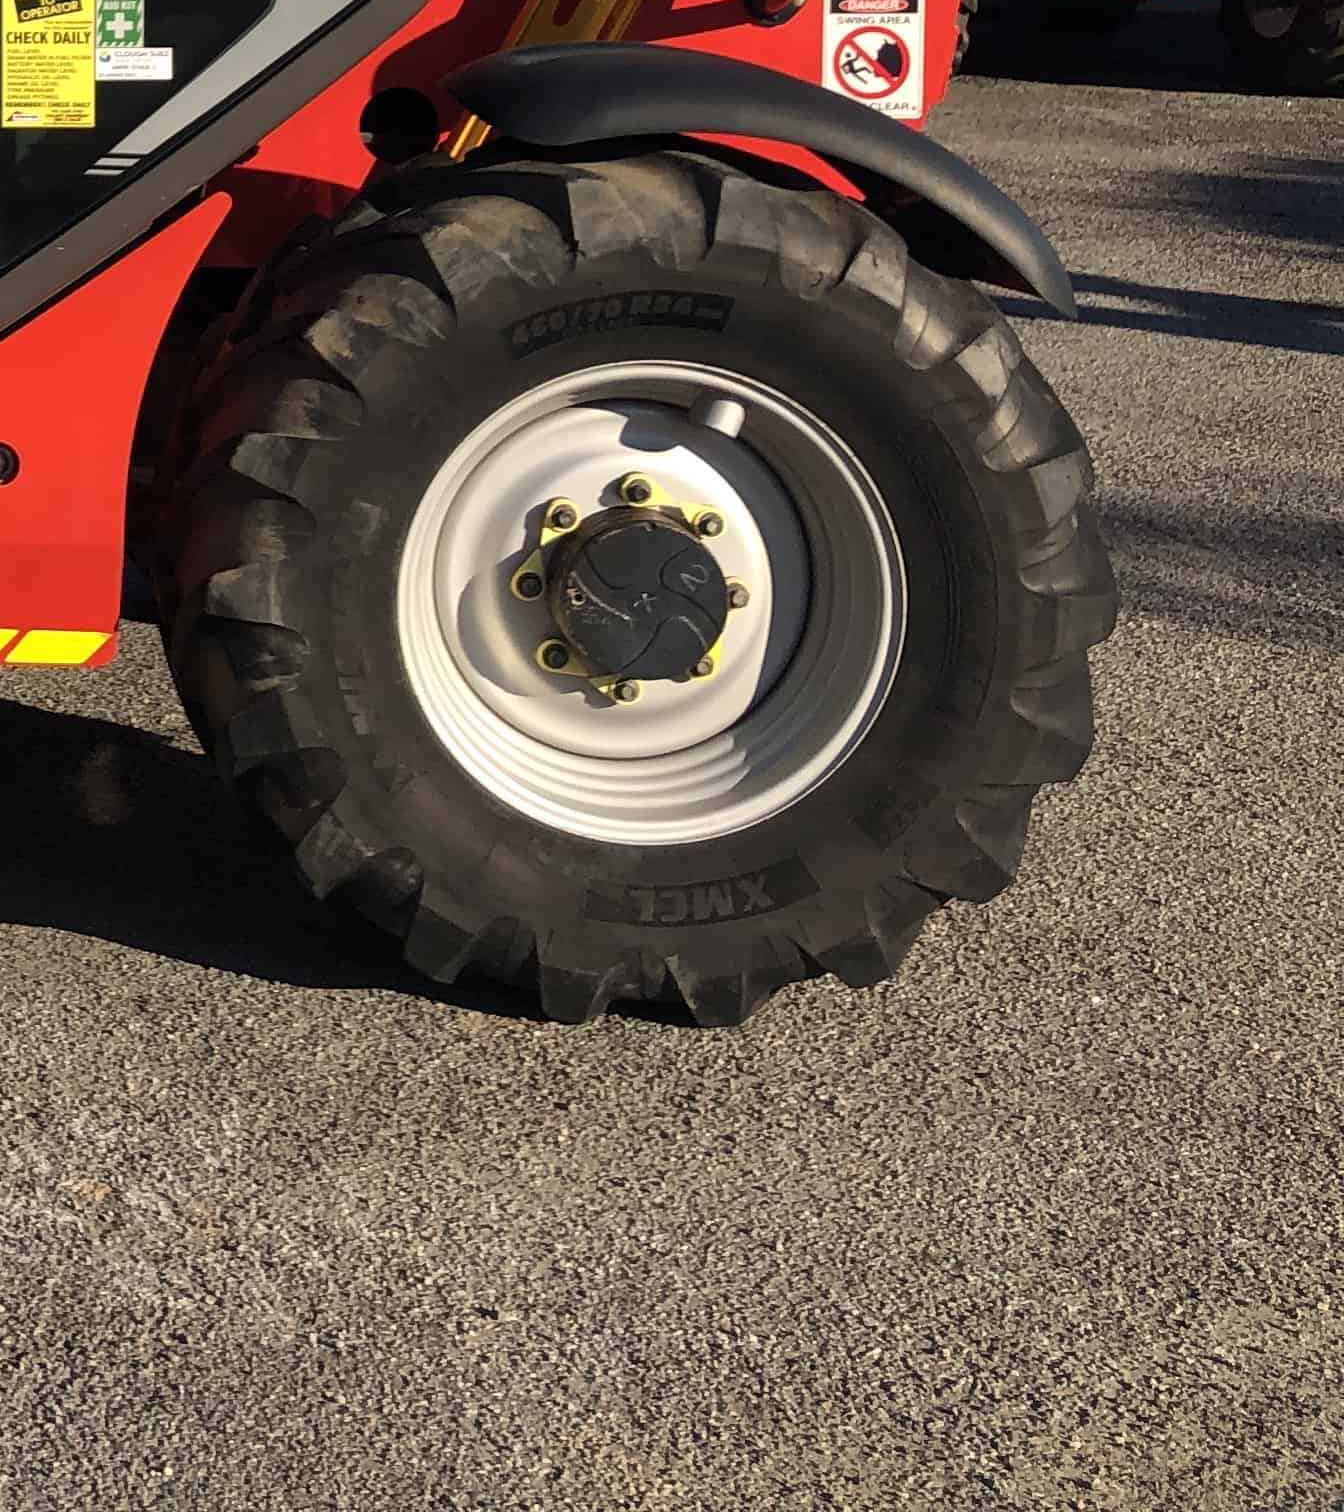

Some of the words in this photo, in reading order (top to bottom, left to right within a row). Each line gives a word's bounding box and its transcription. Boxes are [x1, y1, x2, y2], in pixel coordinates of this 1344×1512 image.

[122, 1, 137, 10] KIT
[847, 0, 900, 9] DANGER
[20, 1, 79, 20] OPERATOR
[836, 16, 876, 24] SWING
[878, 16, 911, 24] AREA
[6, 31, 49, 45] CHECK
[54, 31, 92, 45] DAILY
